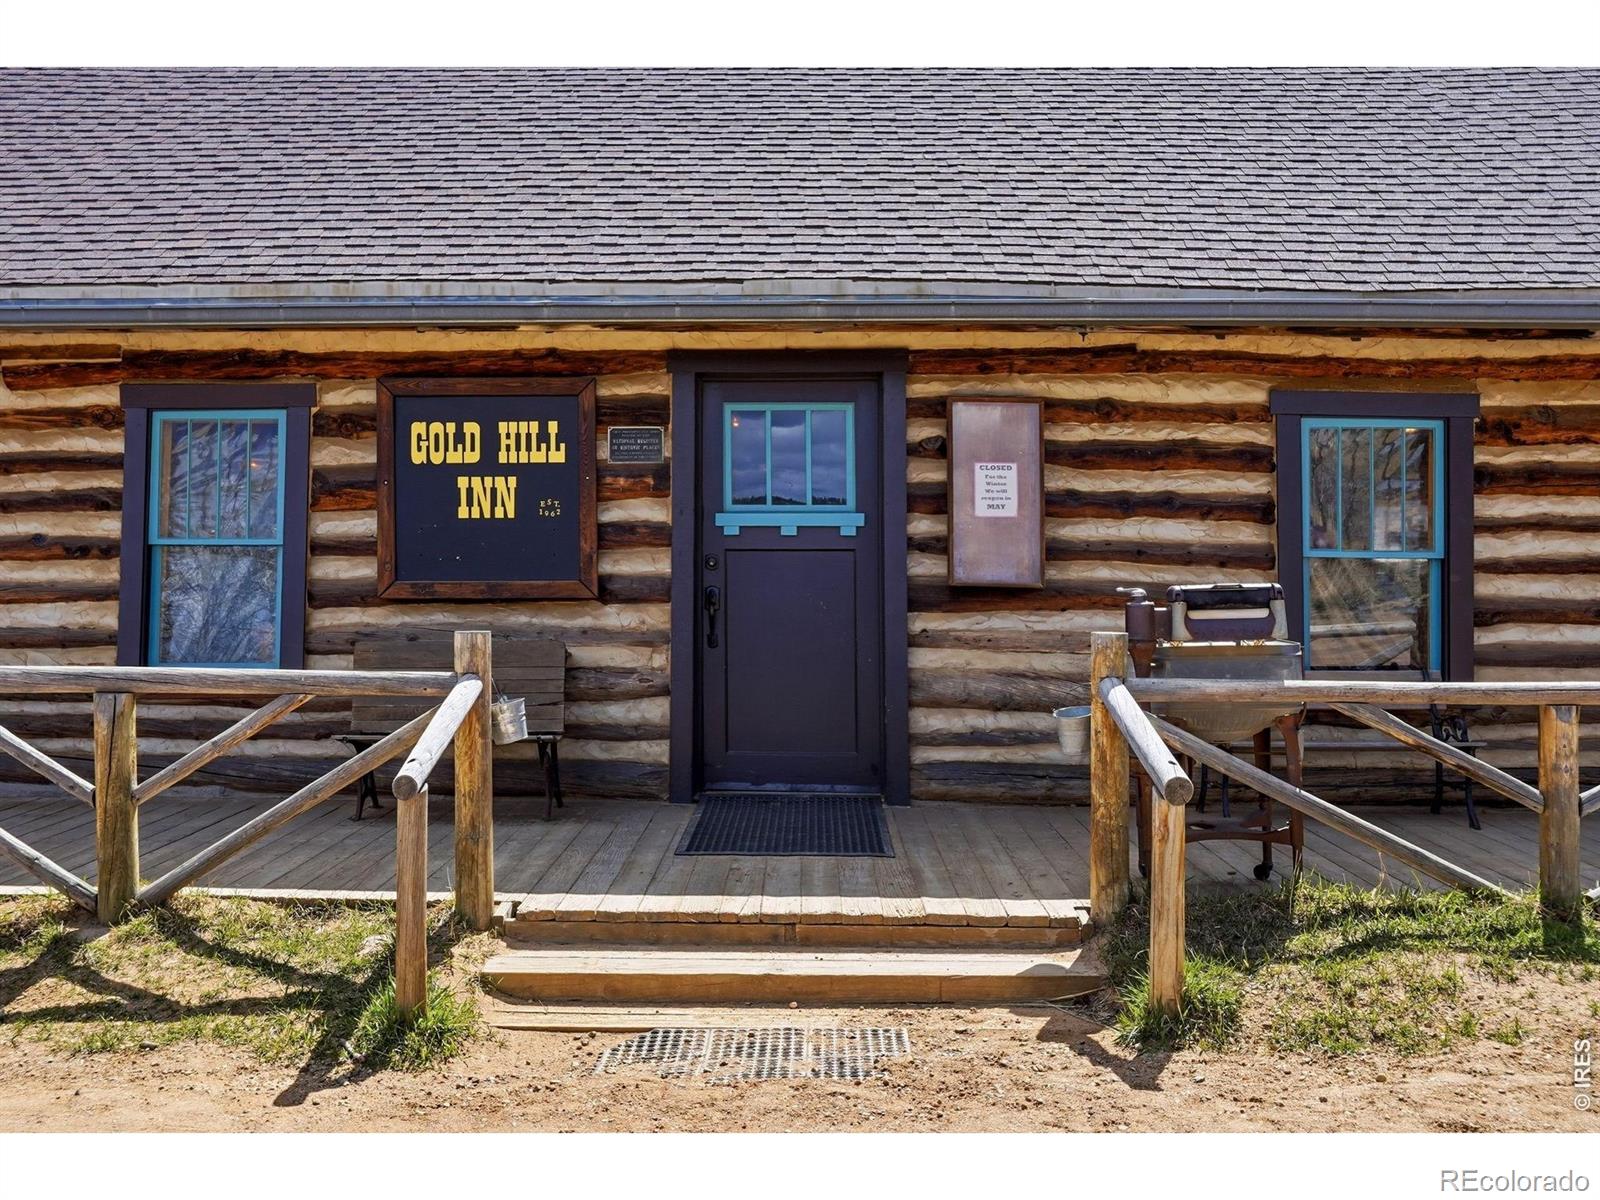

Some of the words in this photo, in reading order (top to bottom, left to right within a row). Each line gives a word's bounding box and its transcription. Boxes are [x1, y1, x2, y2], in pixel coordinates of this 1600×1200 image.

[410, 421, 481, 464] GOLD
[498, 420, 566, 464] HILL
[457, 476, 517, 519] INN
[539, 498, 561, 507] EST.
[538, 508, 562, 518] 1962
